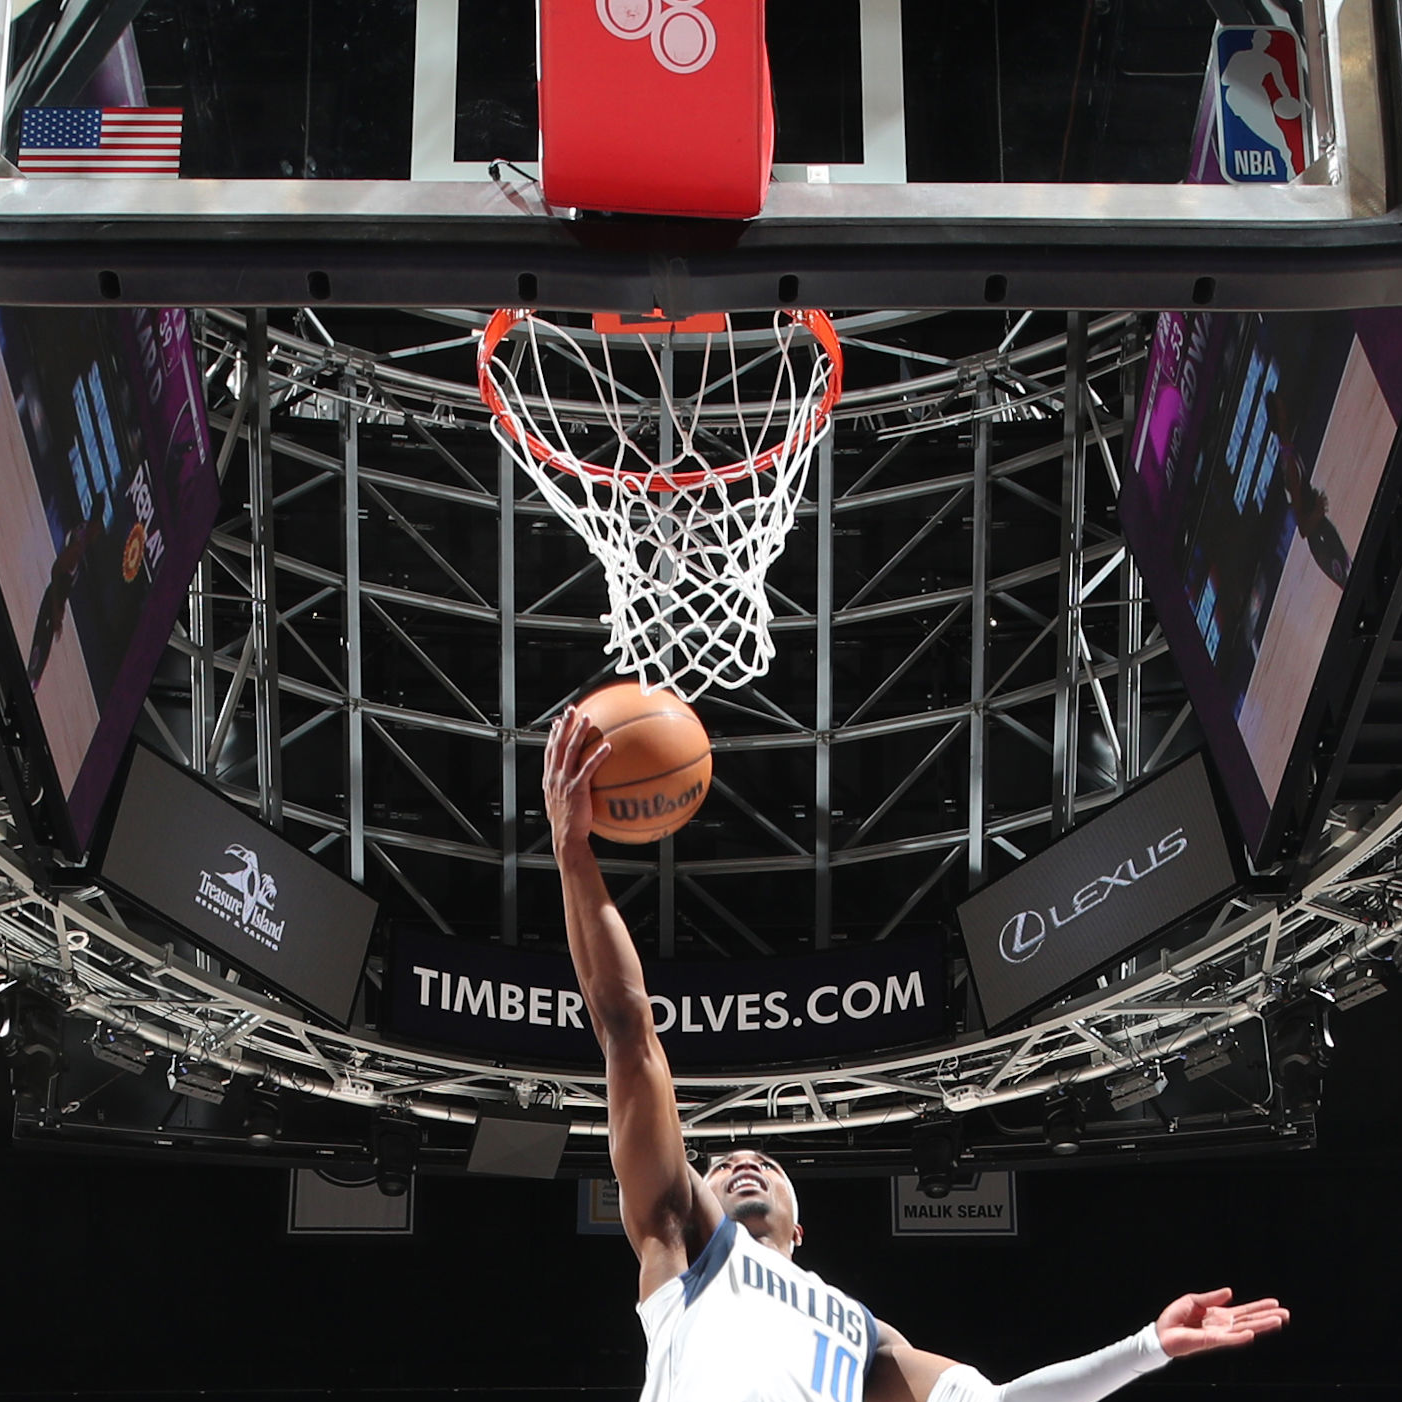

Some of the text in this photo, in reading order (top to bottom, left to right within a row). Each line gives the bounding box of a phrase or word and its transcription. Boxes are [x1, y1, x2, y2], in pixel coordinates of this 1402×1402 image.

[1234, 150, 1277, 176] NBA
[159, 311, 173, 348] 39
[1171, 322, 1184, 360] 53
[127, 463, 166, 569] REPLAY
[606, 781, 704, 821] Wilson
[1049, 827, 1188, 929] LEXUS
[198, 869, 285, 942] Treasure Island
[243, 926, 280, 952] CASINO
[412, 965, 927, 1034] TIMBEROLVES.COM
[904, 1204, 1003, 1218] MALIK SEALY
[743, 1254, 862, 1347] DALLAS
